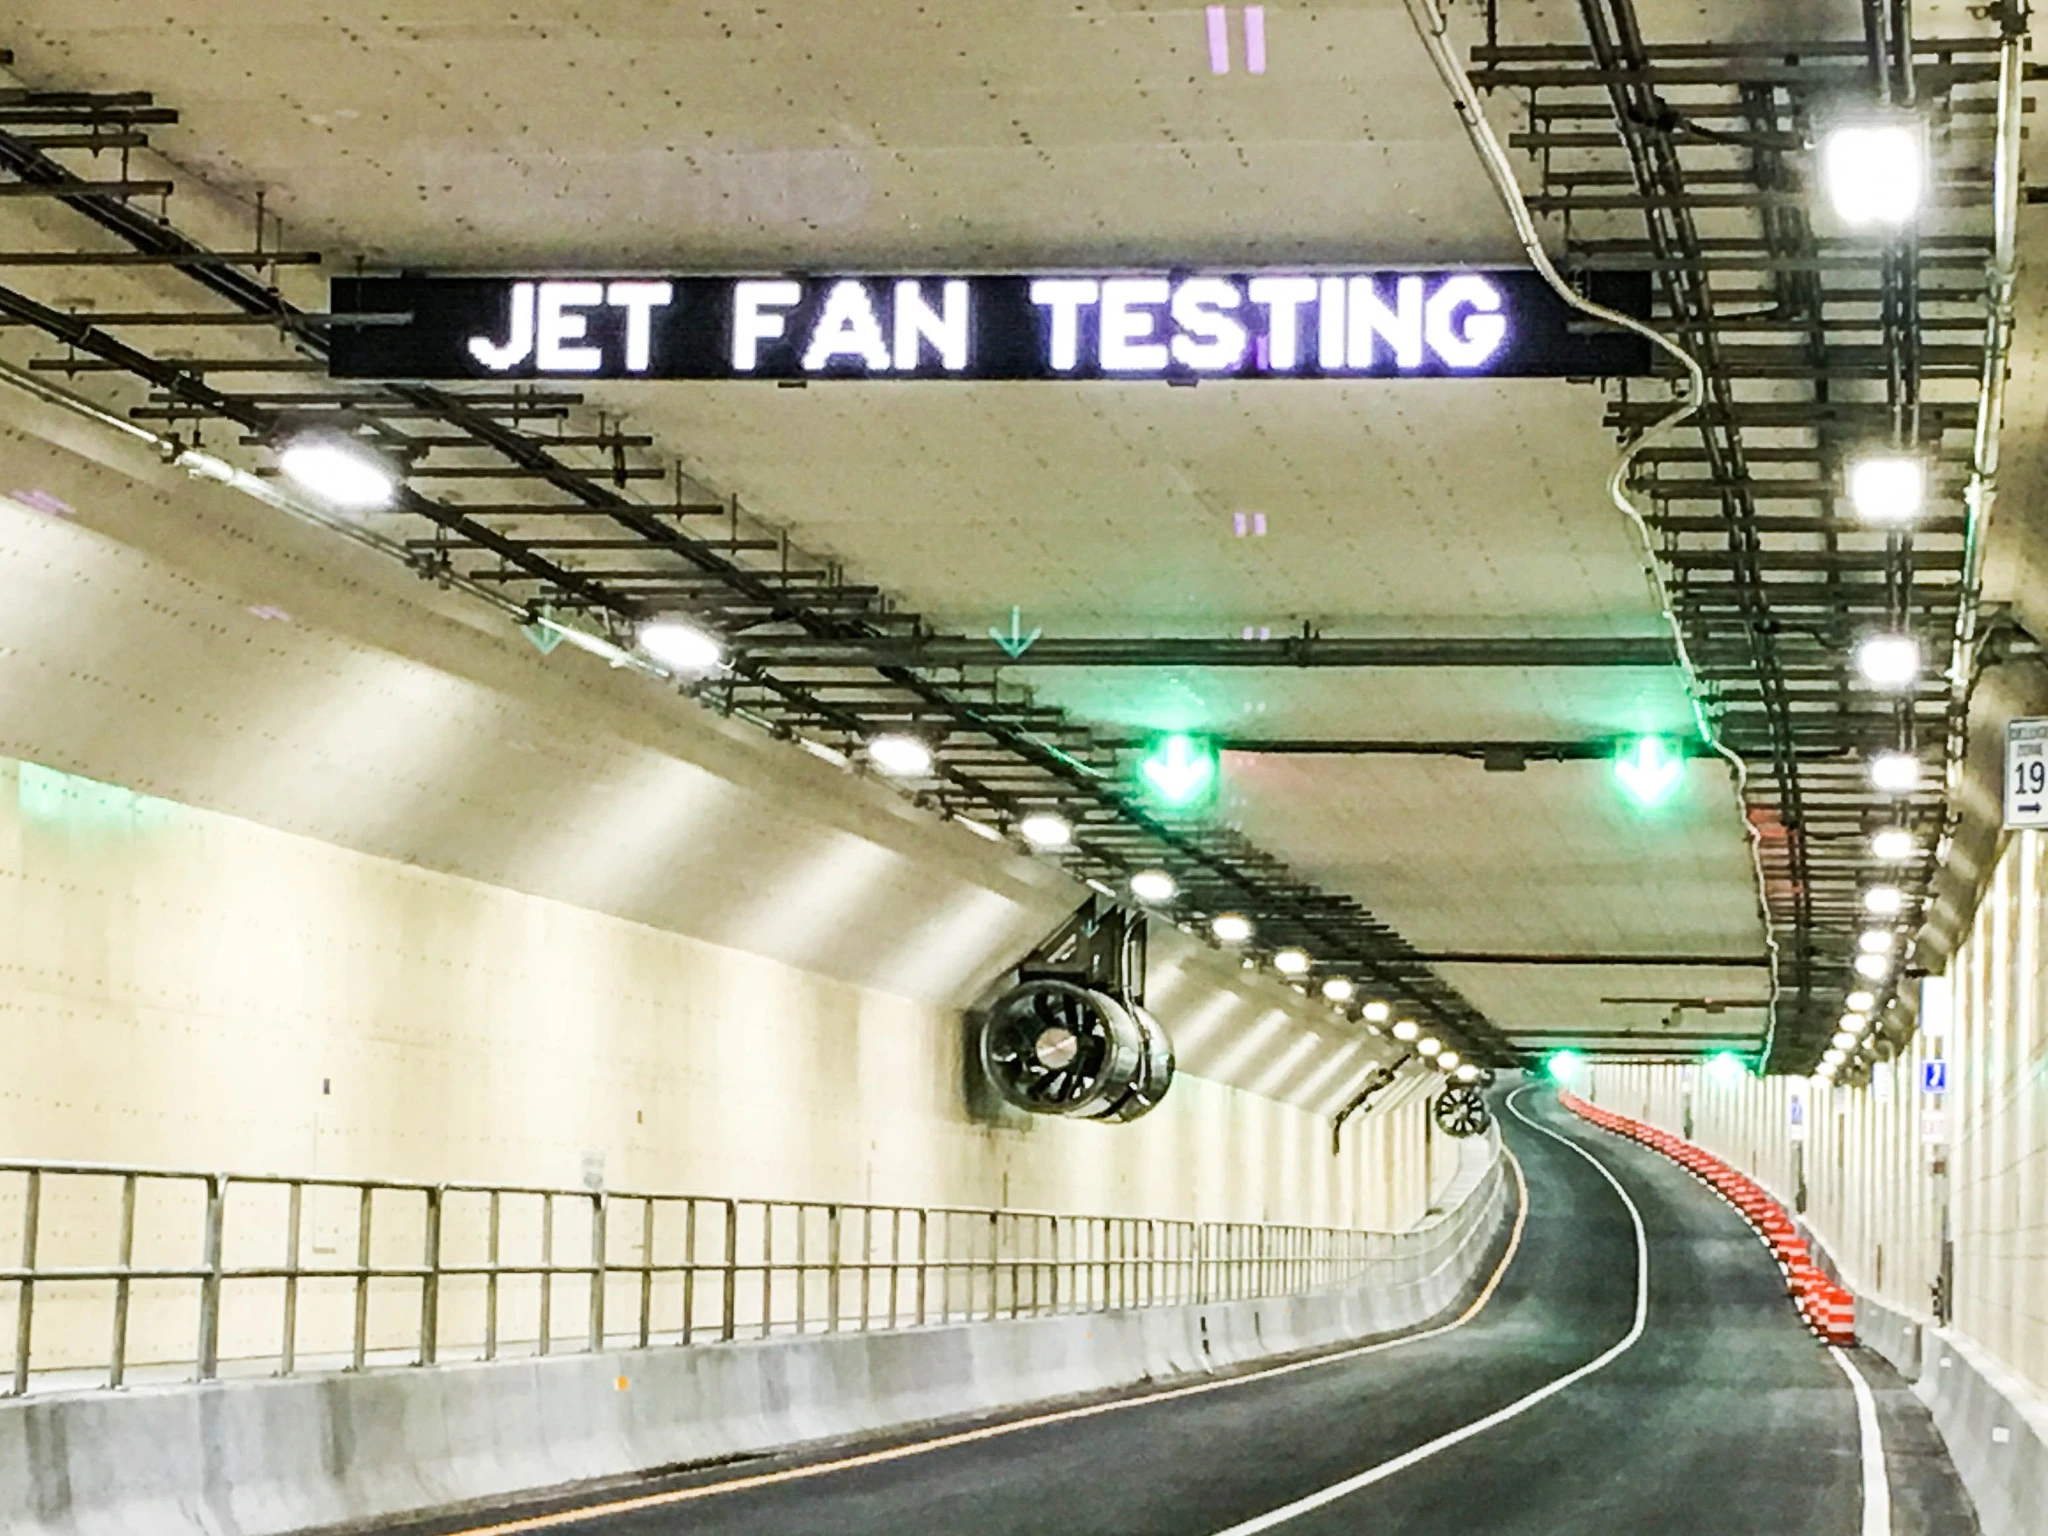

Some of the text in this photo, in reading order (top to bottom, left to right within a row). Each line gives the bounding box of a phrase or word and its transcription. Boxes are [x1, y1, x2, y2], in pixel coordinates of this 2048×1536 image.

[468, 276, 1507, 371] JET FAN TESTING
[2015, 761, 2045, 795] 19
